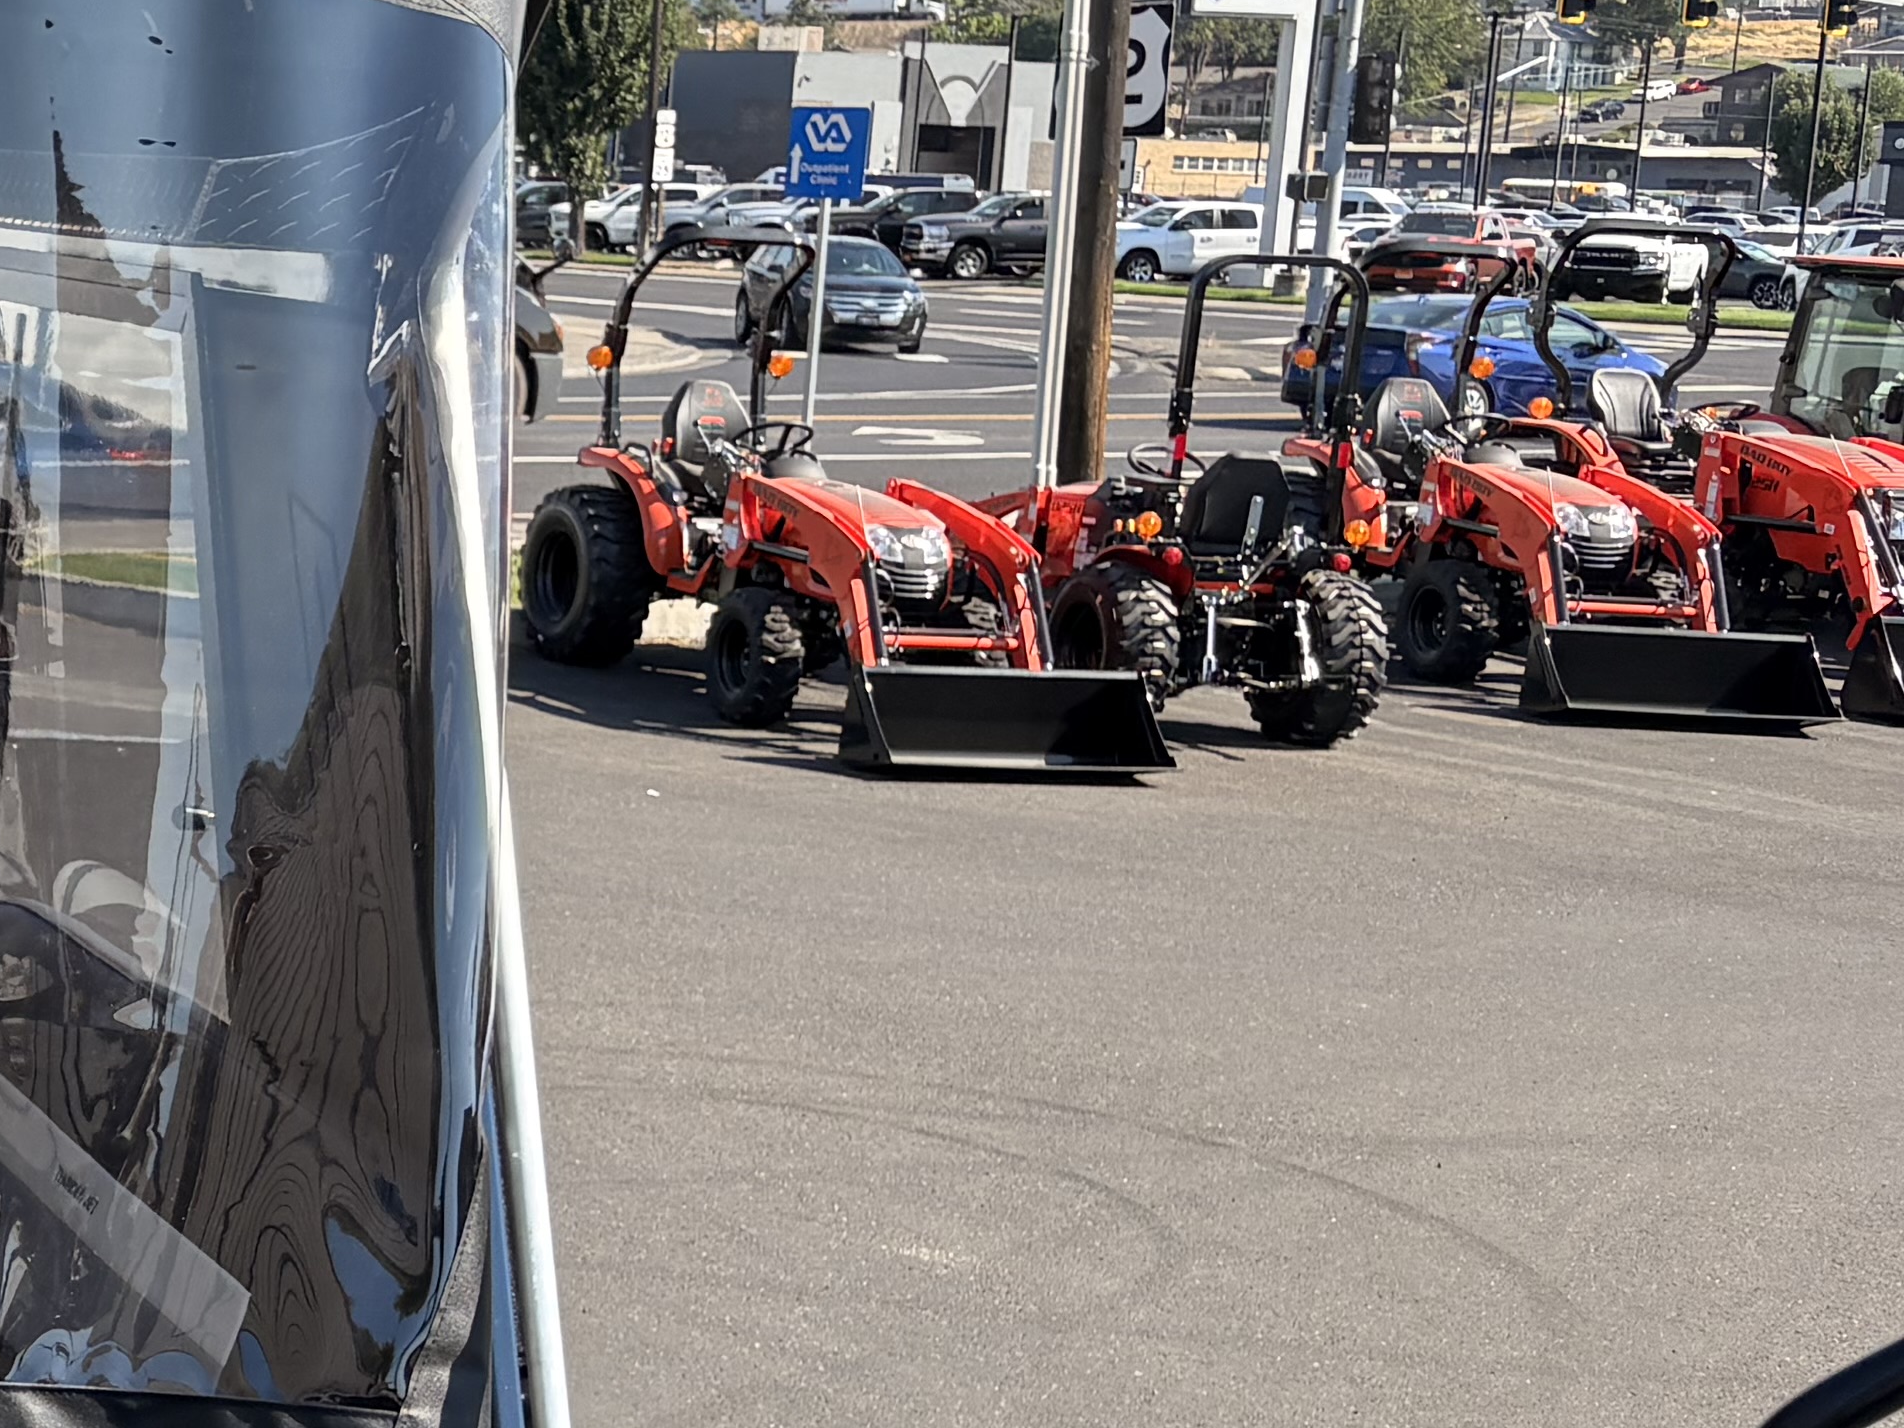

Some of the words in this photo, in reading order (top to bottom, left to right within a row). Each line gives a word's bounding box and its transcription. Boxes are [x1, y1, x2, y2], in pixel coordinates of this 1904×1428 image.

[804, 113, 852, 152] VA
[800, 162, 850, 174] Outpatient
[809, 174, 838, 186] Clinic
